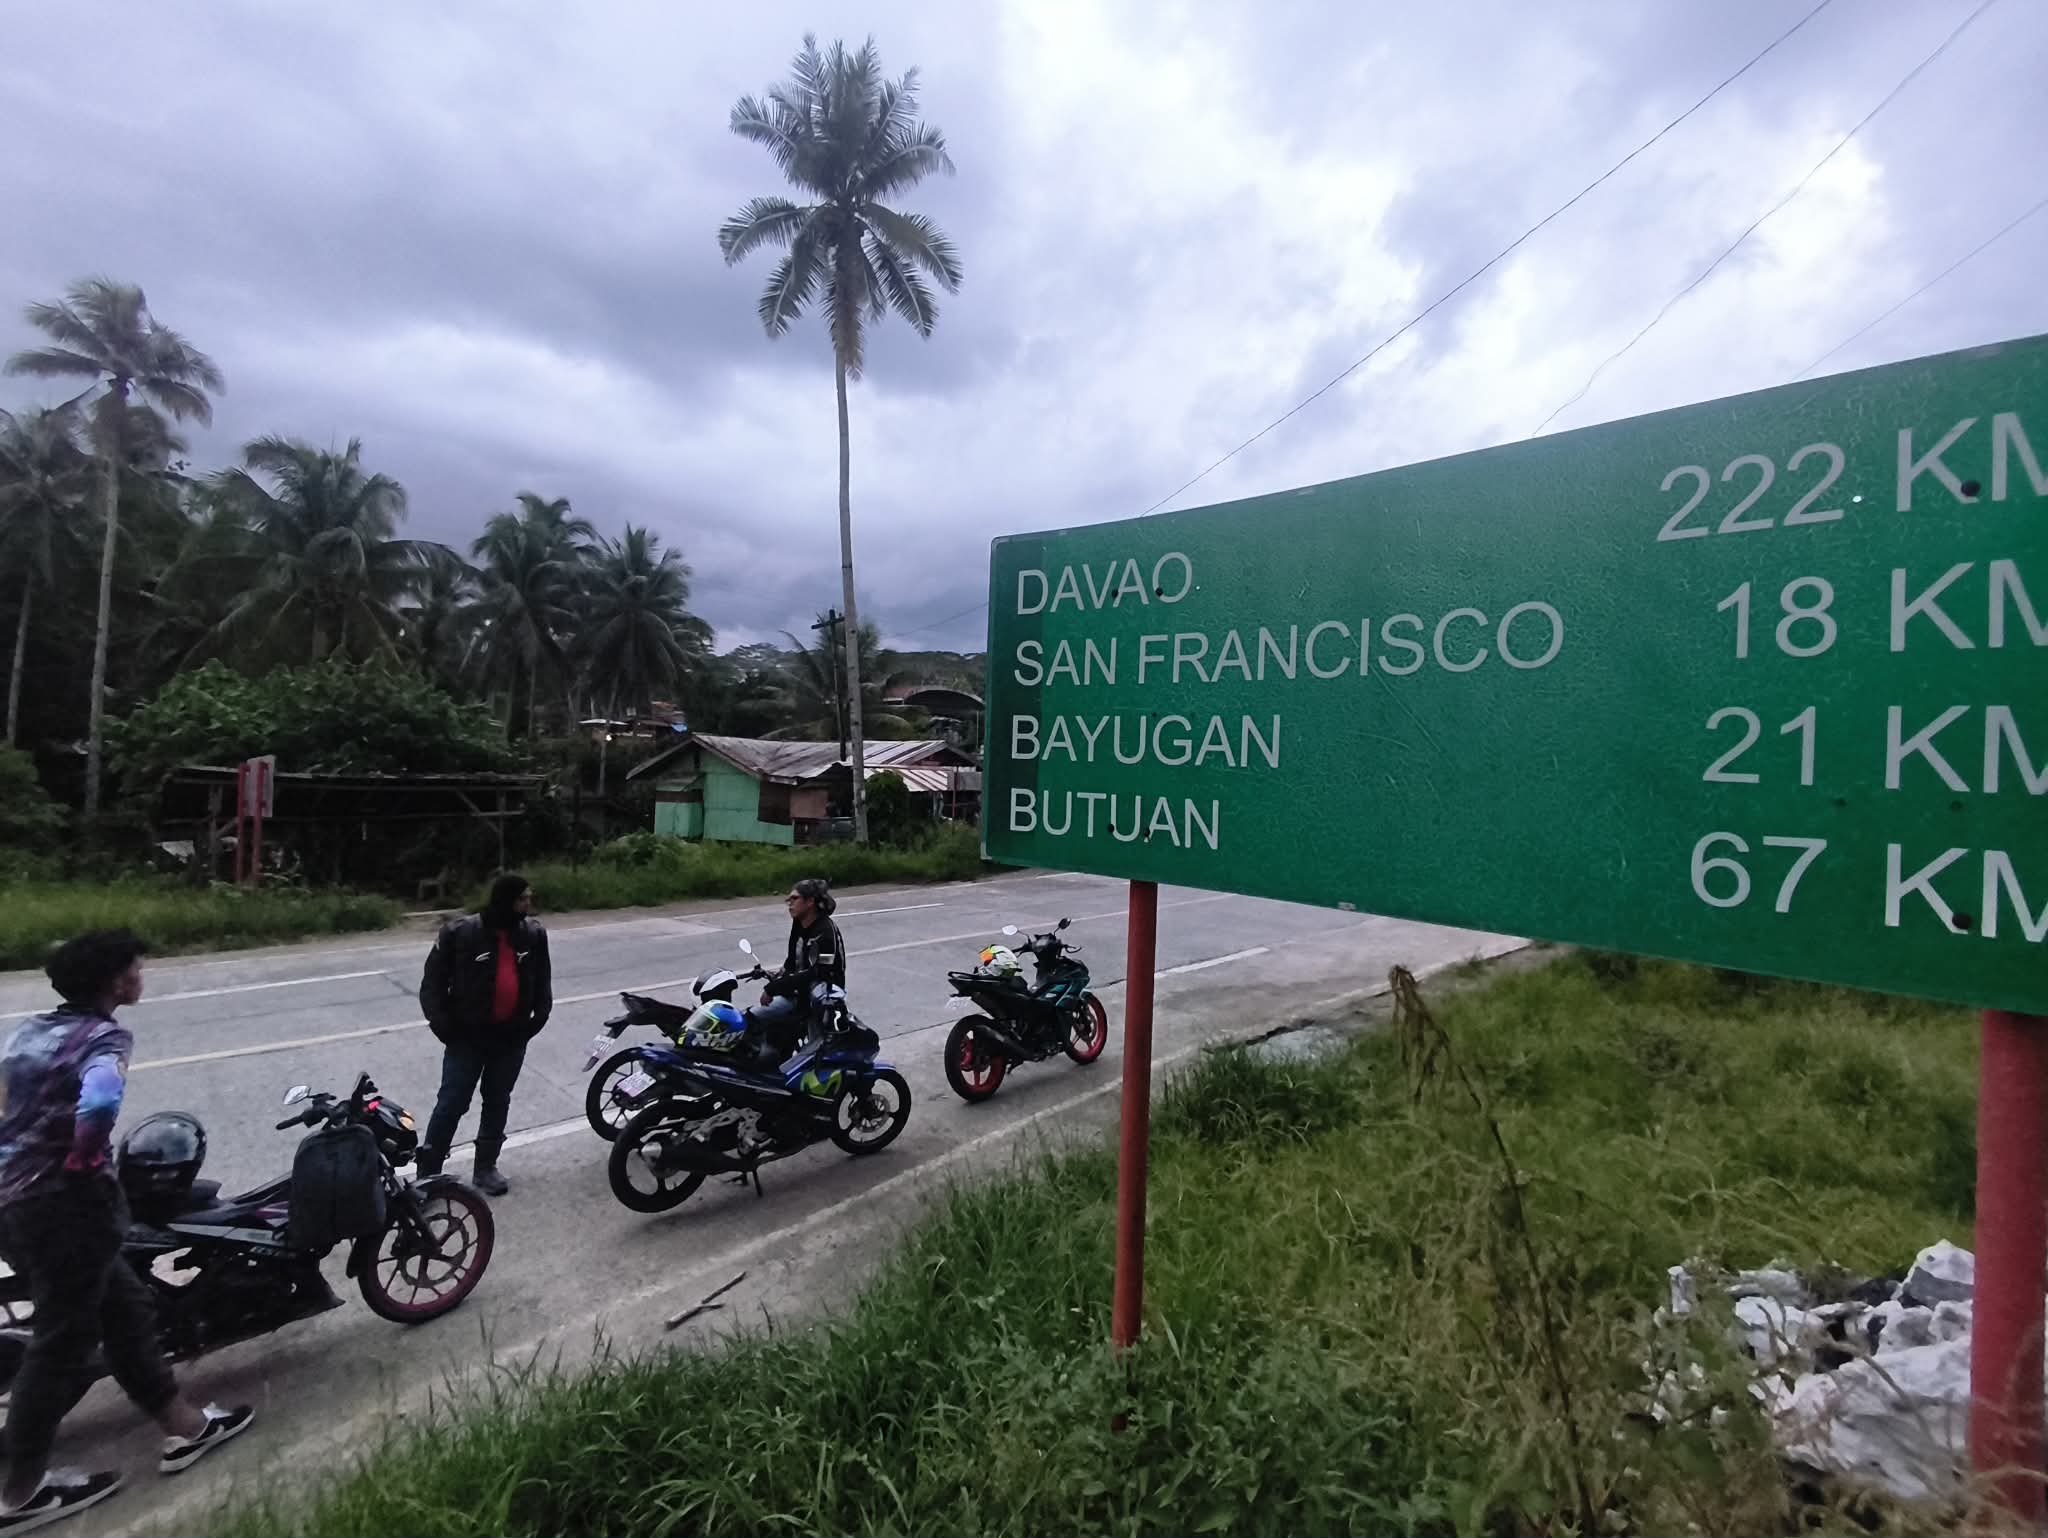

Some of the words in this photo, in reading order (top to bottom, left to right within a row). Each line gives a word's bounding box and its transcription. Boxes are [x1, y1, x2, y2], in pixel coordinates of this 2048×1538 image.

[1017, 551, 1193, 615] DAVAO
[1656, 443, 1846, 542] 222
[1014, 639, 1118, 686] SAN
[1138, 602, 1564, 684] FRANCISCO
[1716, 577, 1837, 658] 18
[1011, 714, 1281, 769] BAYUGAN
[1703, 708, 1816, 785] 21
[1009, 787, 1219, 850] BUTUAN
[1691, 832, 1827, 913] 67
